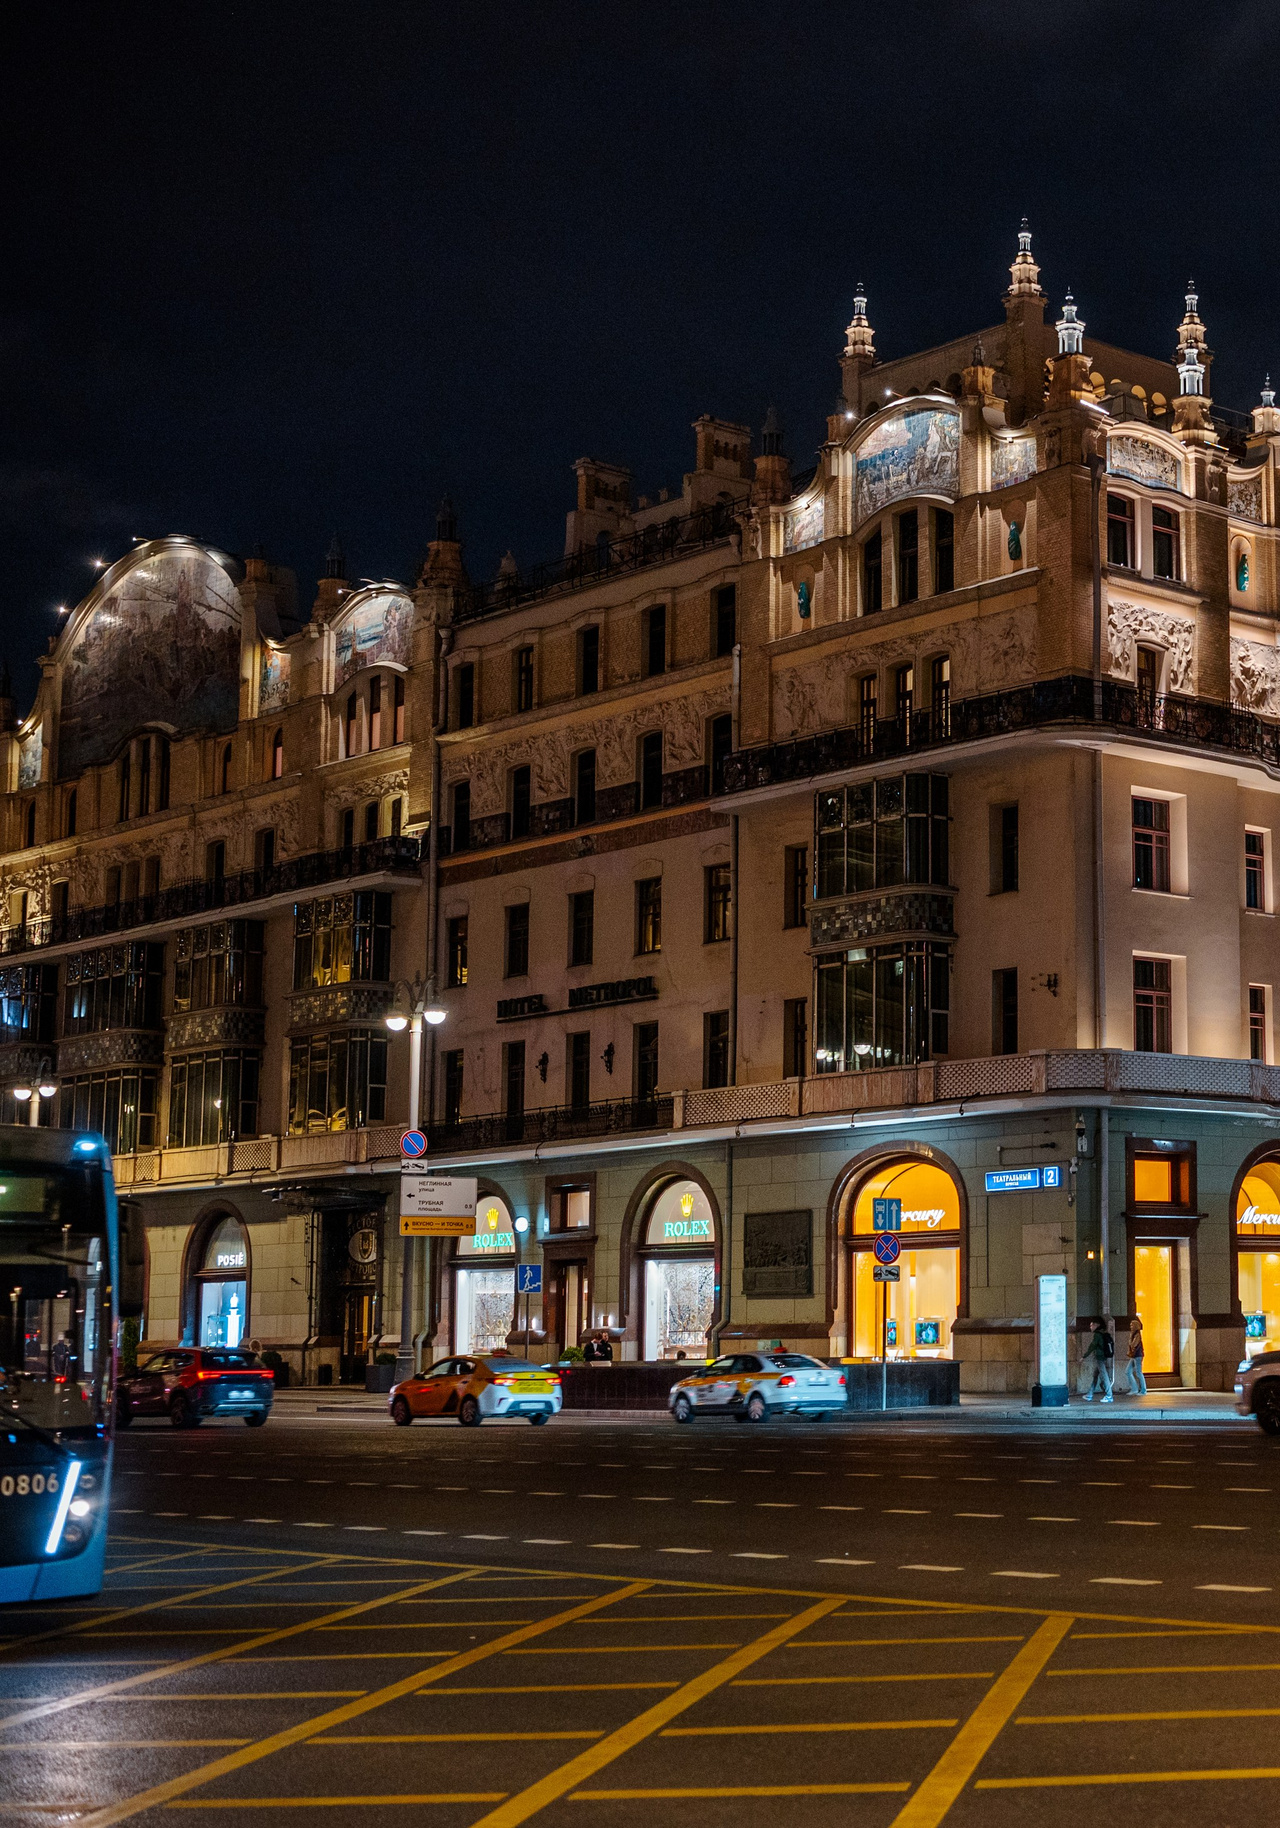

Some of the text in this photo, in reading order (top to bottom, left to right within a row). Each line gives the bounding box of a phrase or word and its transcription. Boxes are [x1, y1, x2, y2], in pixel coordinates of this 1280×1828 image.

[568, 976, 659, 1007] METROPOL
[992, 1172, 1032, 1183] ТЕАТРАЛЬНЫЙ
[1047, 1170, 1055, 1184] 2
[900, 1208, 946, 1228] ercury
[664, 1220, 710, 1237] ROLEX
[472, 1232, 514, 1249] ROLEX
